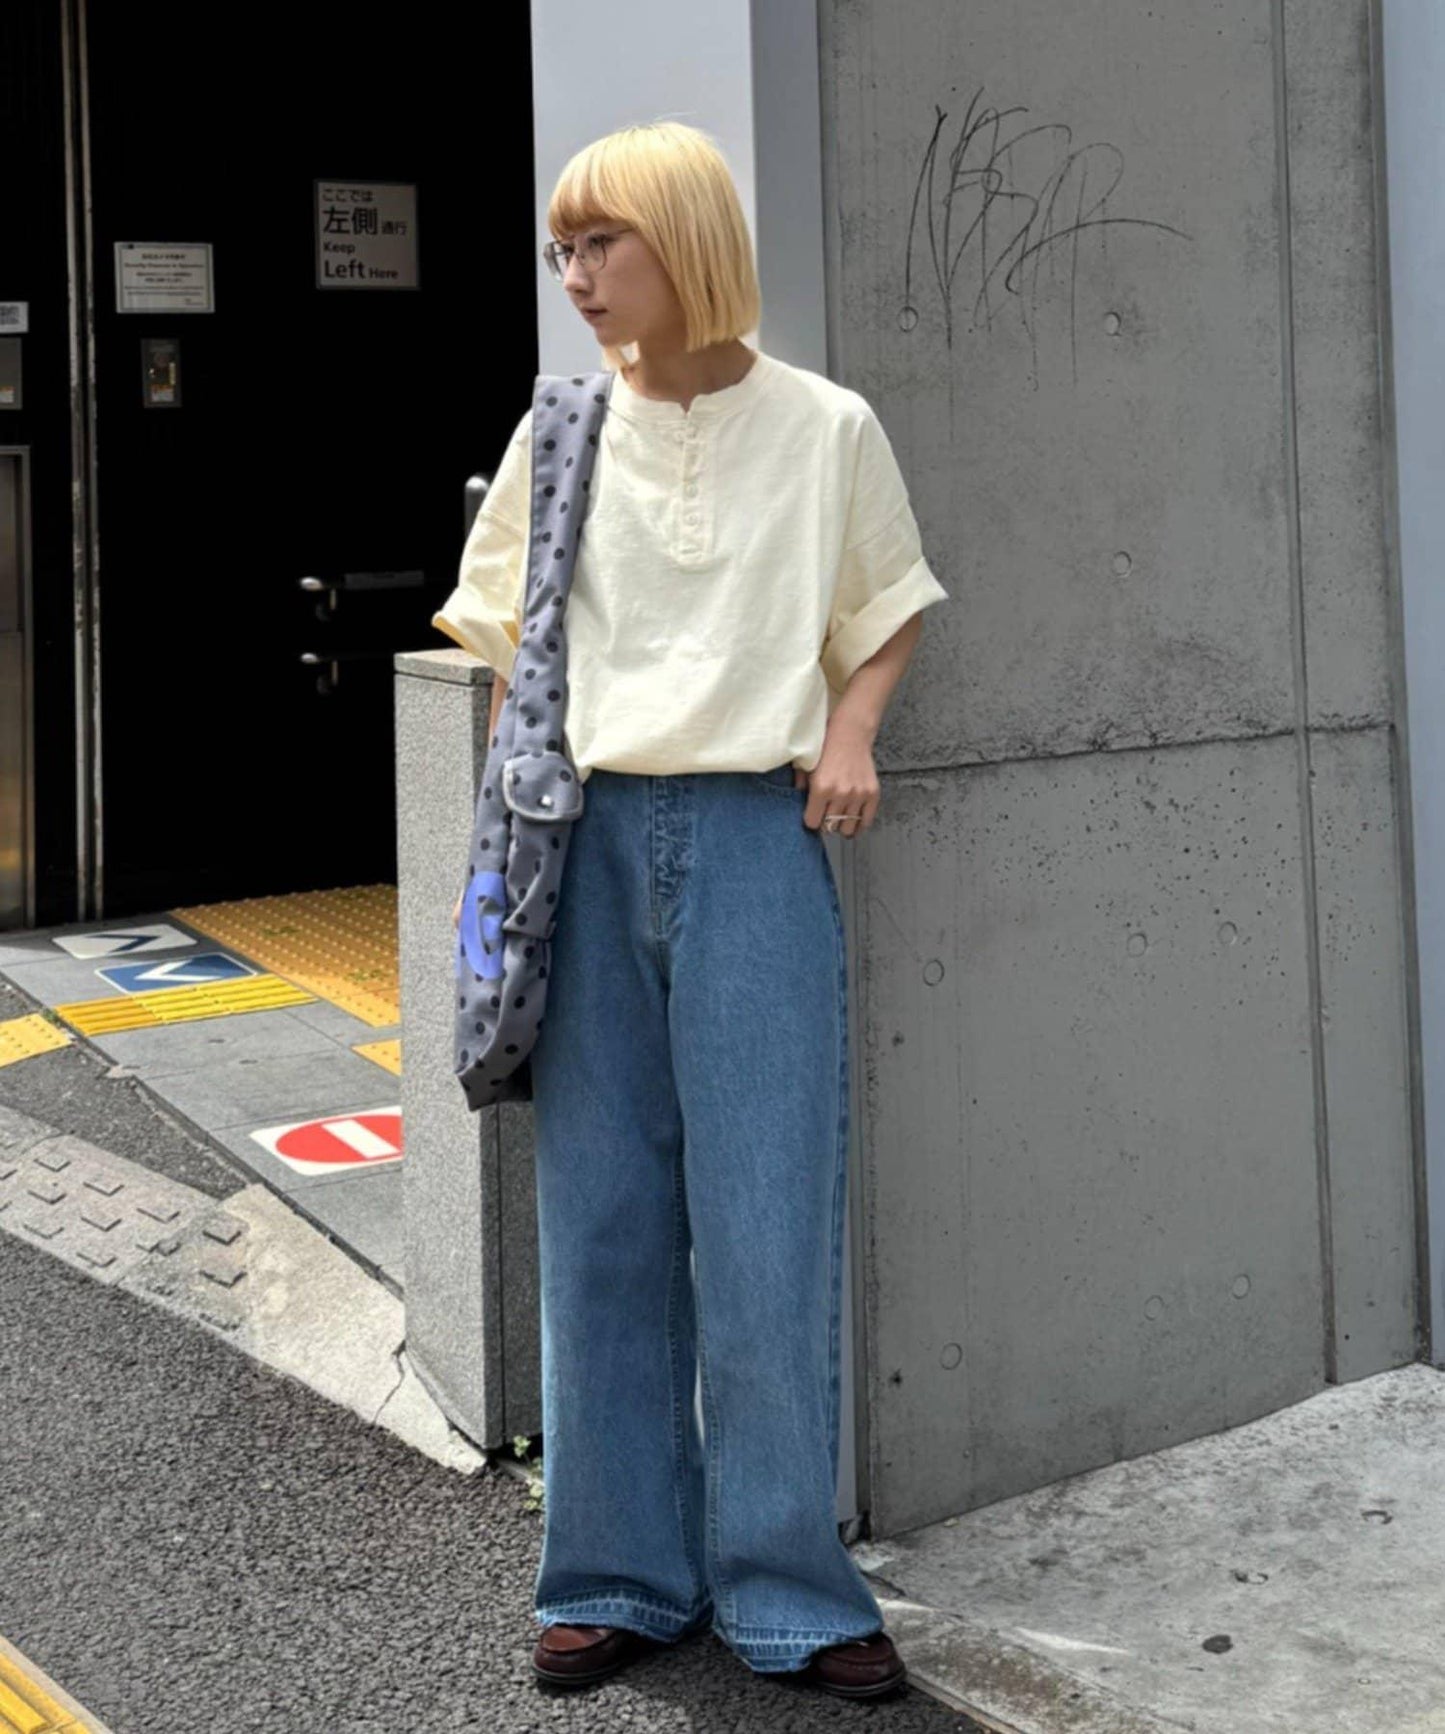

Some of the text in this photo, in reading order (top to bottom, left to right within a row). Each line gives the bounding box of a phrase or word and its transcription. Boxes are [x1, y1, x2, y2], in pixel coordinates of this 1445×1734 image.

[322, 189, 373, 202] ここでは
[323, 242, 355, 254] Keep
[325, 259, 398, 279] Left Here
